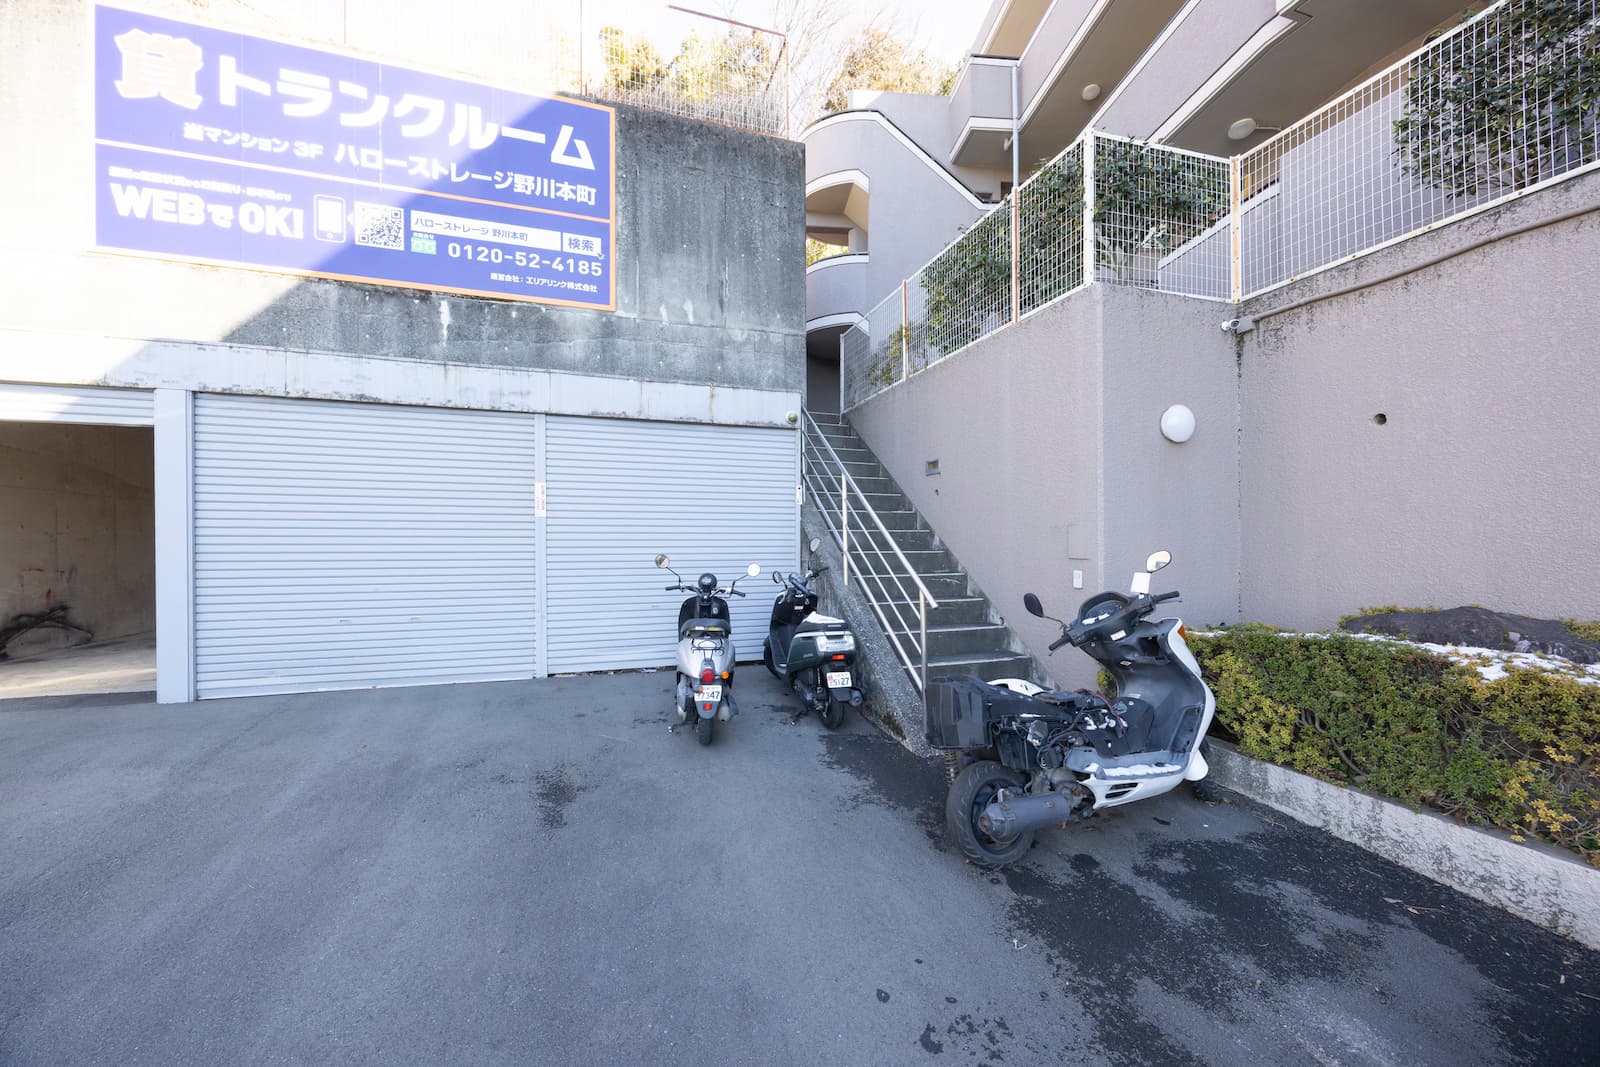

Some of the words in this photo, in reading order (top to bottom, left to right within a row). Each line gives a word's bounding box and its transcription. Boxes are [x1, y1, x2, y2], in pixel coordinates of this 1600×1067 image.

[334, 143, 597, 206] ハローストレージ野川本町
[447, 242, 602, 276] 0120-52-4185
[567, 236, 595, 252] 検索
